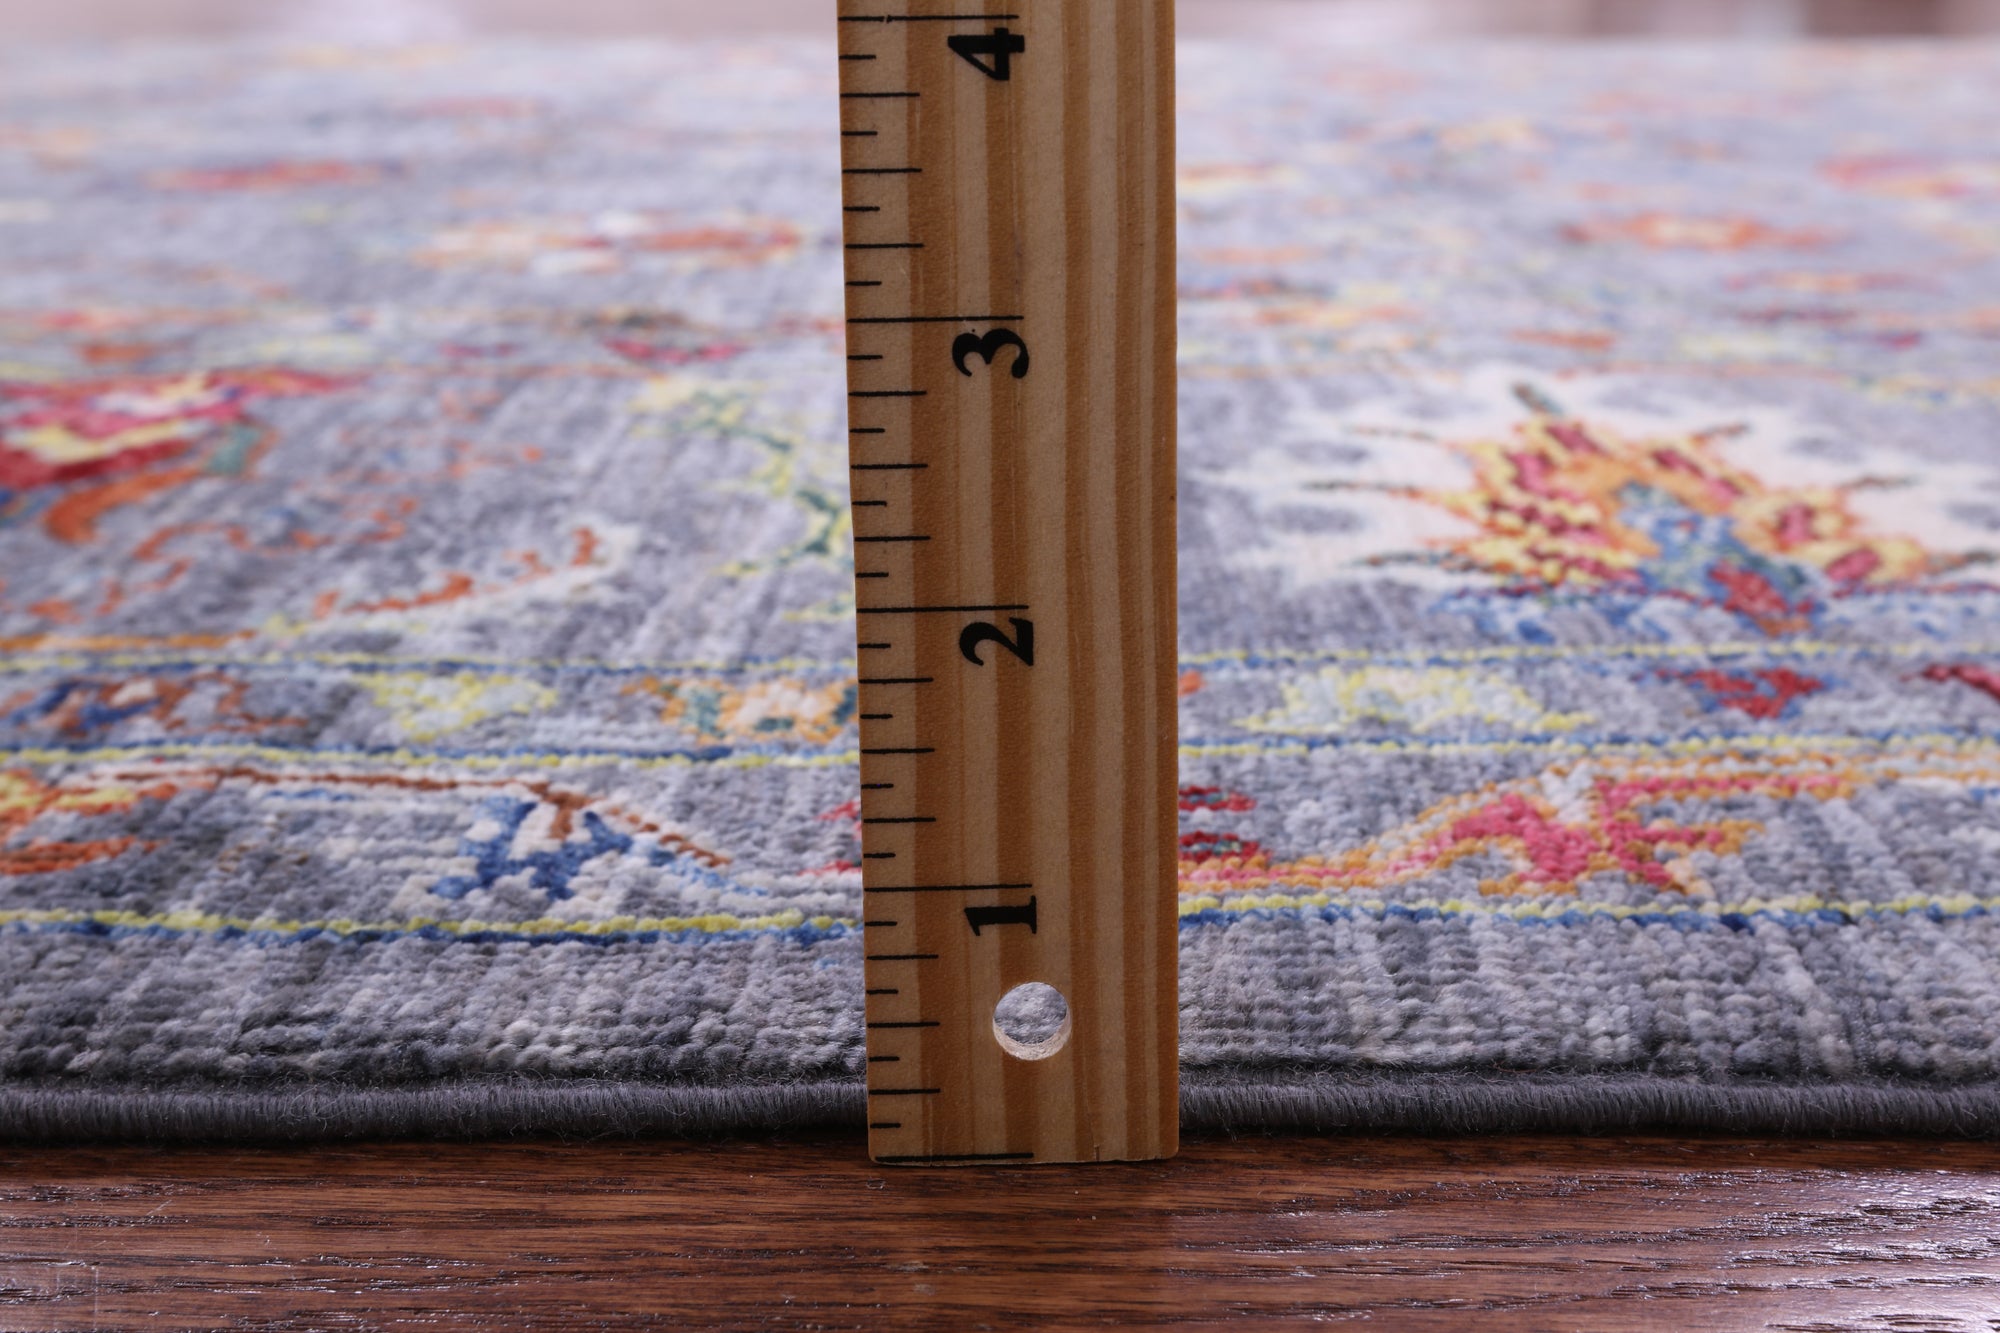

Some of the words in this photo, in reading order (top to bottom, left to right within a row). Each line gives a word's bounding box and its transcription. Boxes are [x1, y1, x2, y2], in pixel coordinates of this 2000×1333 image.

[947, 27, 1025, 82] 4
[951, 327, 1030, 380] 3
[958, 616, 1035, 668] 2
[963, 895, 1038, 937] 1
